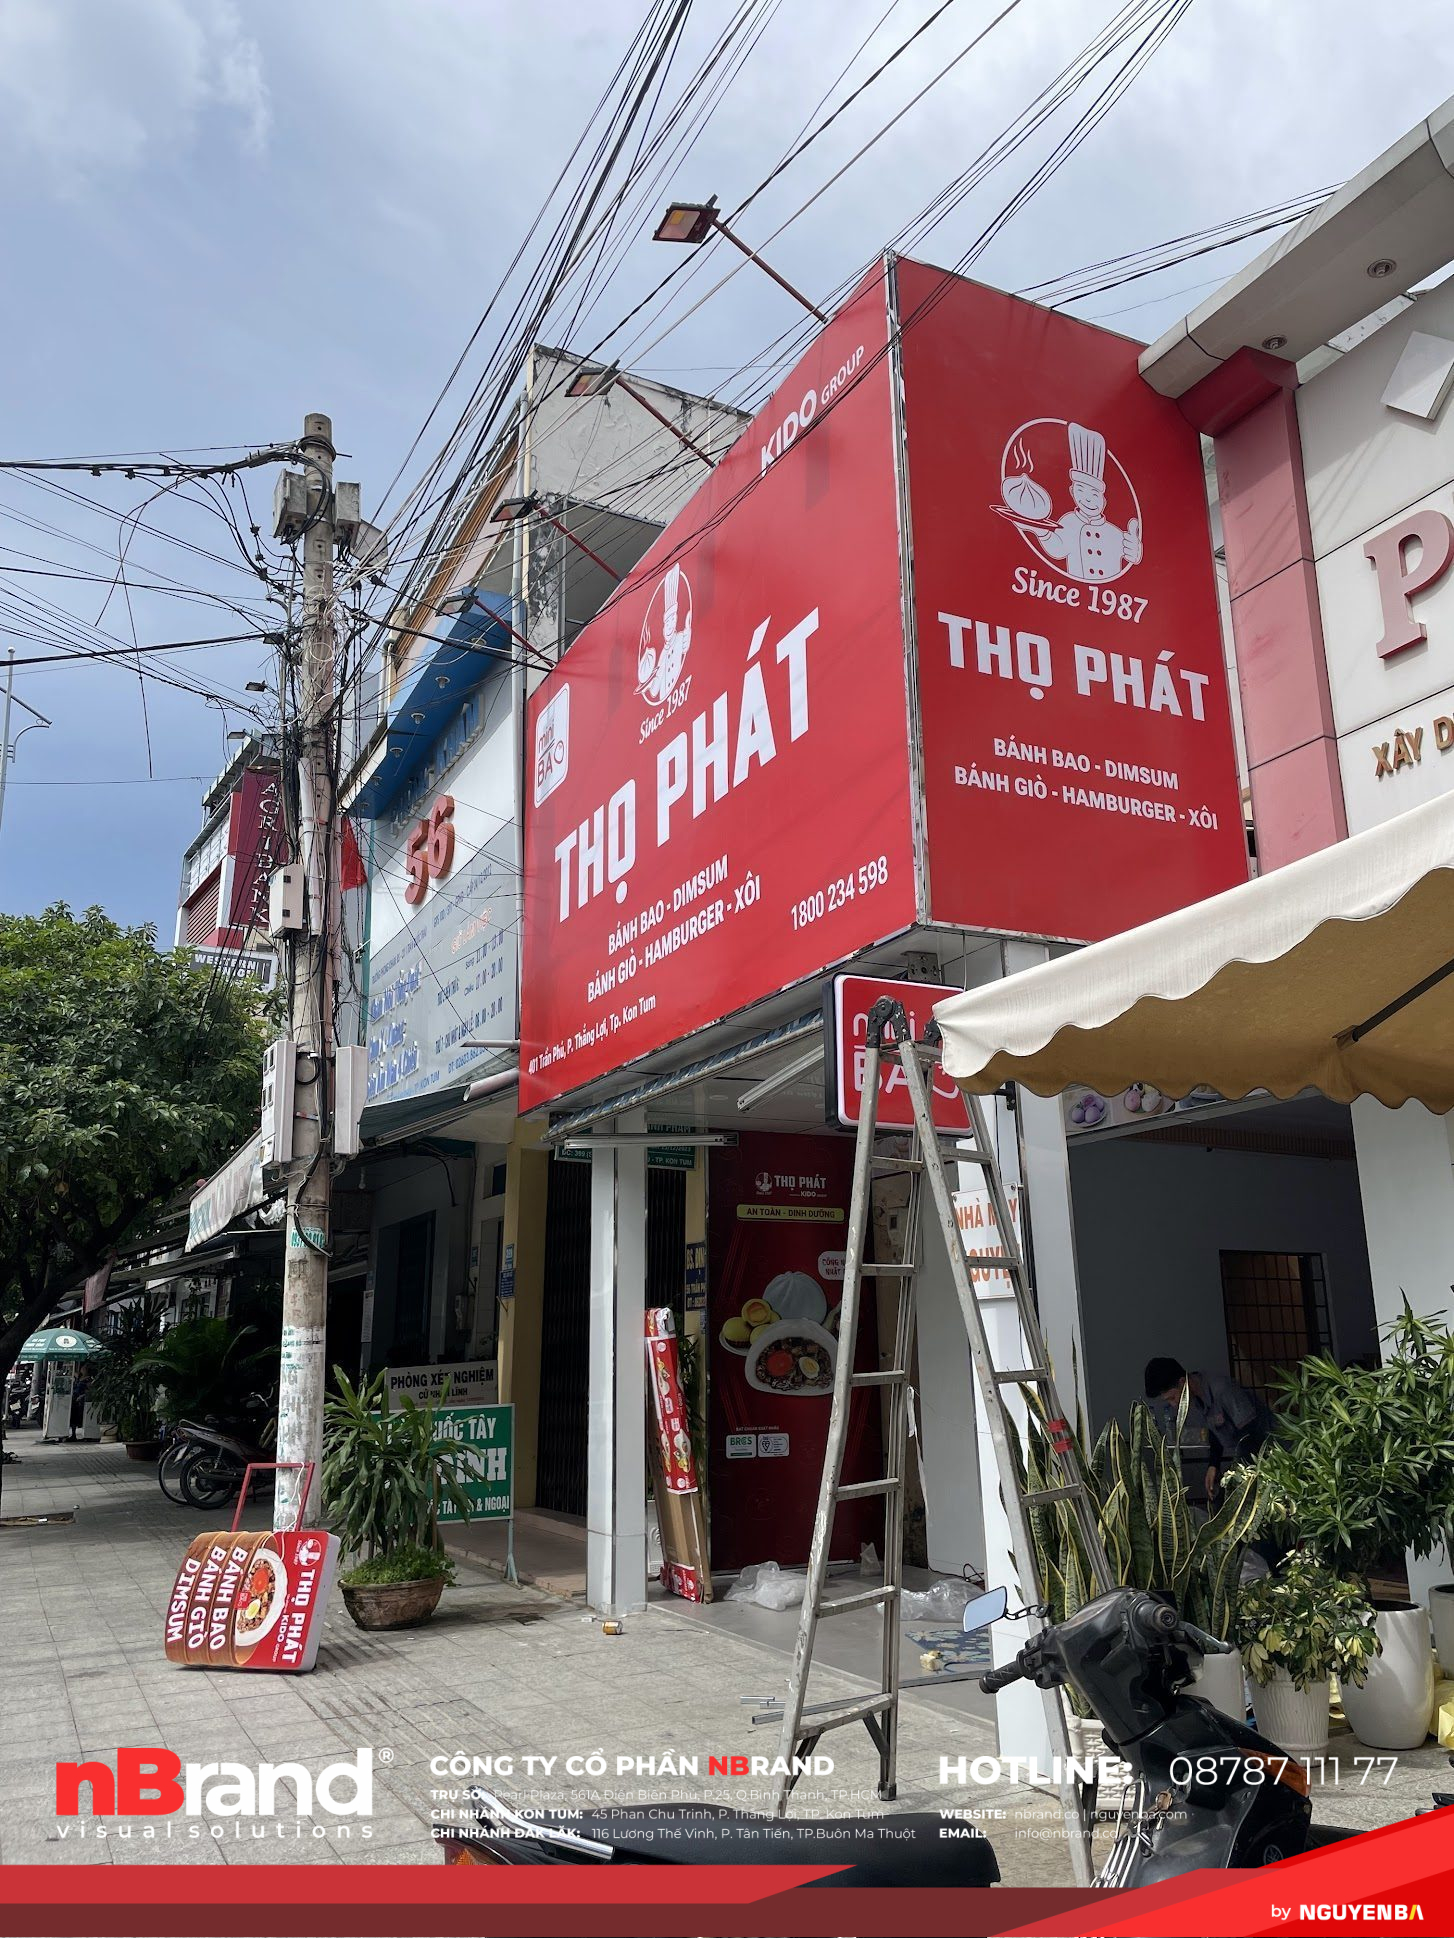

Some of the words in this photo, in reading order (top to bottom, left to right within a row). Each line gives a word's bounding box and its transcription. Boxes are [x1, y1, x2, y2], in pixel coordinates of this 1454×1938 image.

[761, 389, 817, 477] KIDO
[821, 345, 864, 405] GROUP
[1011, 566, 1080, 607] Since
[1087, 585, 1149, 624] 1987
[937, 611, 1053, 700] THỌ
[1073, 643, 1210, 722] PHÁT
[639, 708, 665, 745] Since
[666, 674, 692, 719] 1987
[554, 778, 636, 923] THỌ
[656, 606, 820, 848] PHÁT
[993, 734, 1048, 766] BÁNH
[1051, 748, 1091, 773] BAO
[1104, 759, 1179, 790] DIMSUM
[1371, 727, 1423, 778] XÂY
[1433, 713, 1454, 750] D
[954, 761, 1010, 793] BÁNH
[1014, 773, 1048, 800] GIÒ
[1062, 785, 1177, 823] HAMBURGER
[1188, 804, 1219, 831] XÔI
[405, 794, 455, 905] 56
[608, 917, 638, 955] BÁNH
[640, 900, 665, 935] BAO
[673, 854, 728, 912] DIMSUM
[791, 890, 825, 931] 1800
[827, 872, 855, 912] 234
[858, 855, 889, 895] 598
[194, 953, 257, 970] WESTERN
[587, 966, 616, 1003] BÁNH
[617, 947, 637, 984] GIÒ
[644, 899, 725, 969] HAMBURGER
[734, 870, 761, 914] XÔI
[528, 1058, 539, 1076] 401
[566, 1037, 574, 1055] P.
[609, 1012, 622, 1034] Tp.
[622, 1005, 638, 1025] Kon
[638, 994, 657, 1016] Tum
[665, 1157, 678, 1165] KON
[679, 1158, 692, 1166] TUM
[773, 1175, 796, 1191] THỌ
[798, 1173, 827, 1190] PHÁT
[746, 1208, 758, 1216] AN
[760, 1207, 781, 1217] TOÀN
[788, 1209, 807, 1218] DINH
[987, 1198, 1018, 1226] MY
[391, 1371, 428, 1390] PHÒNG
[454, 1366, 494, 1385] NGHIỆM
[468, 1413, 497, 1440] TÂY
[484, 1495, 510, 1513] NGOẠI
[167, 1557, 201, 1643] DIMSUM
[195, 1546, 227, 1601] BÁNH
[216, 1546, 249, 1603] BÁNH
[291, 1568, 315, 1606] THỌ
[188, 1606, 209, 1649] GIÒ
[209, 1607, 229, 1650] BAO
[276, 1614, 290, 1643] KIDO
[281, 1612, 306, 1663] PHÁT
